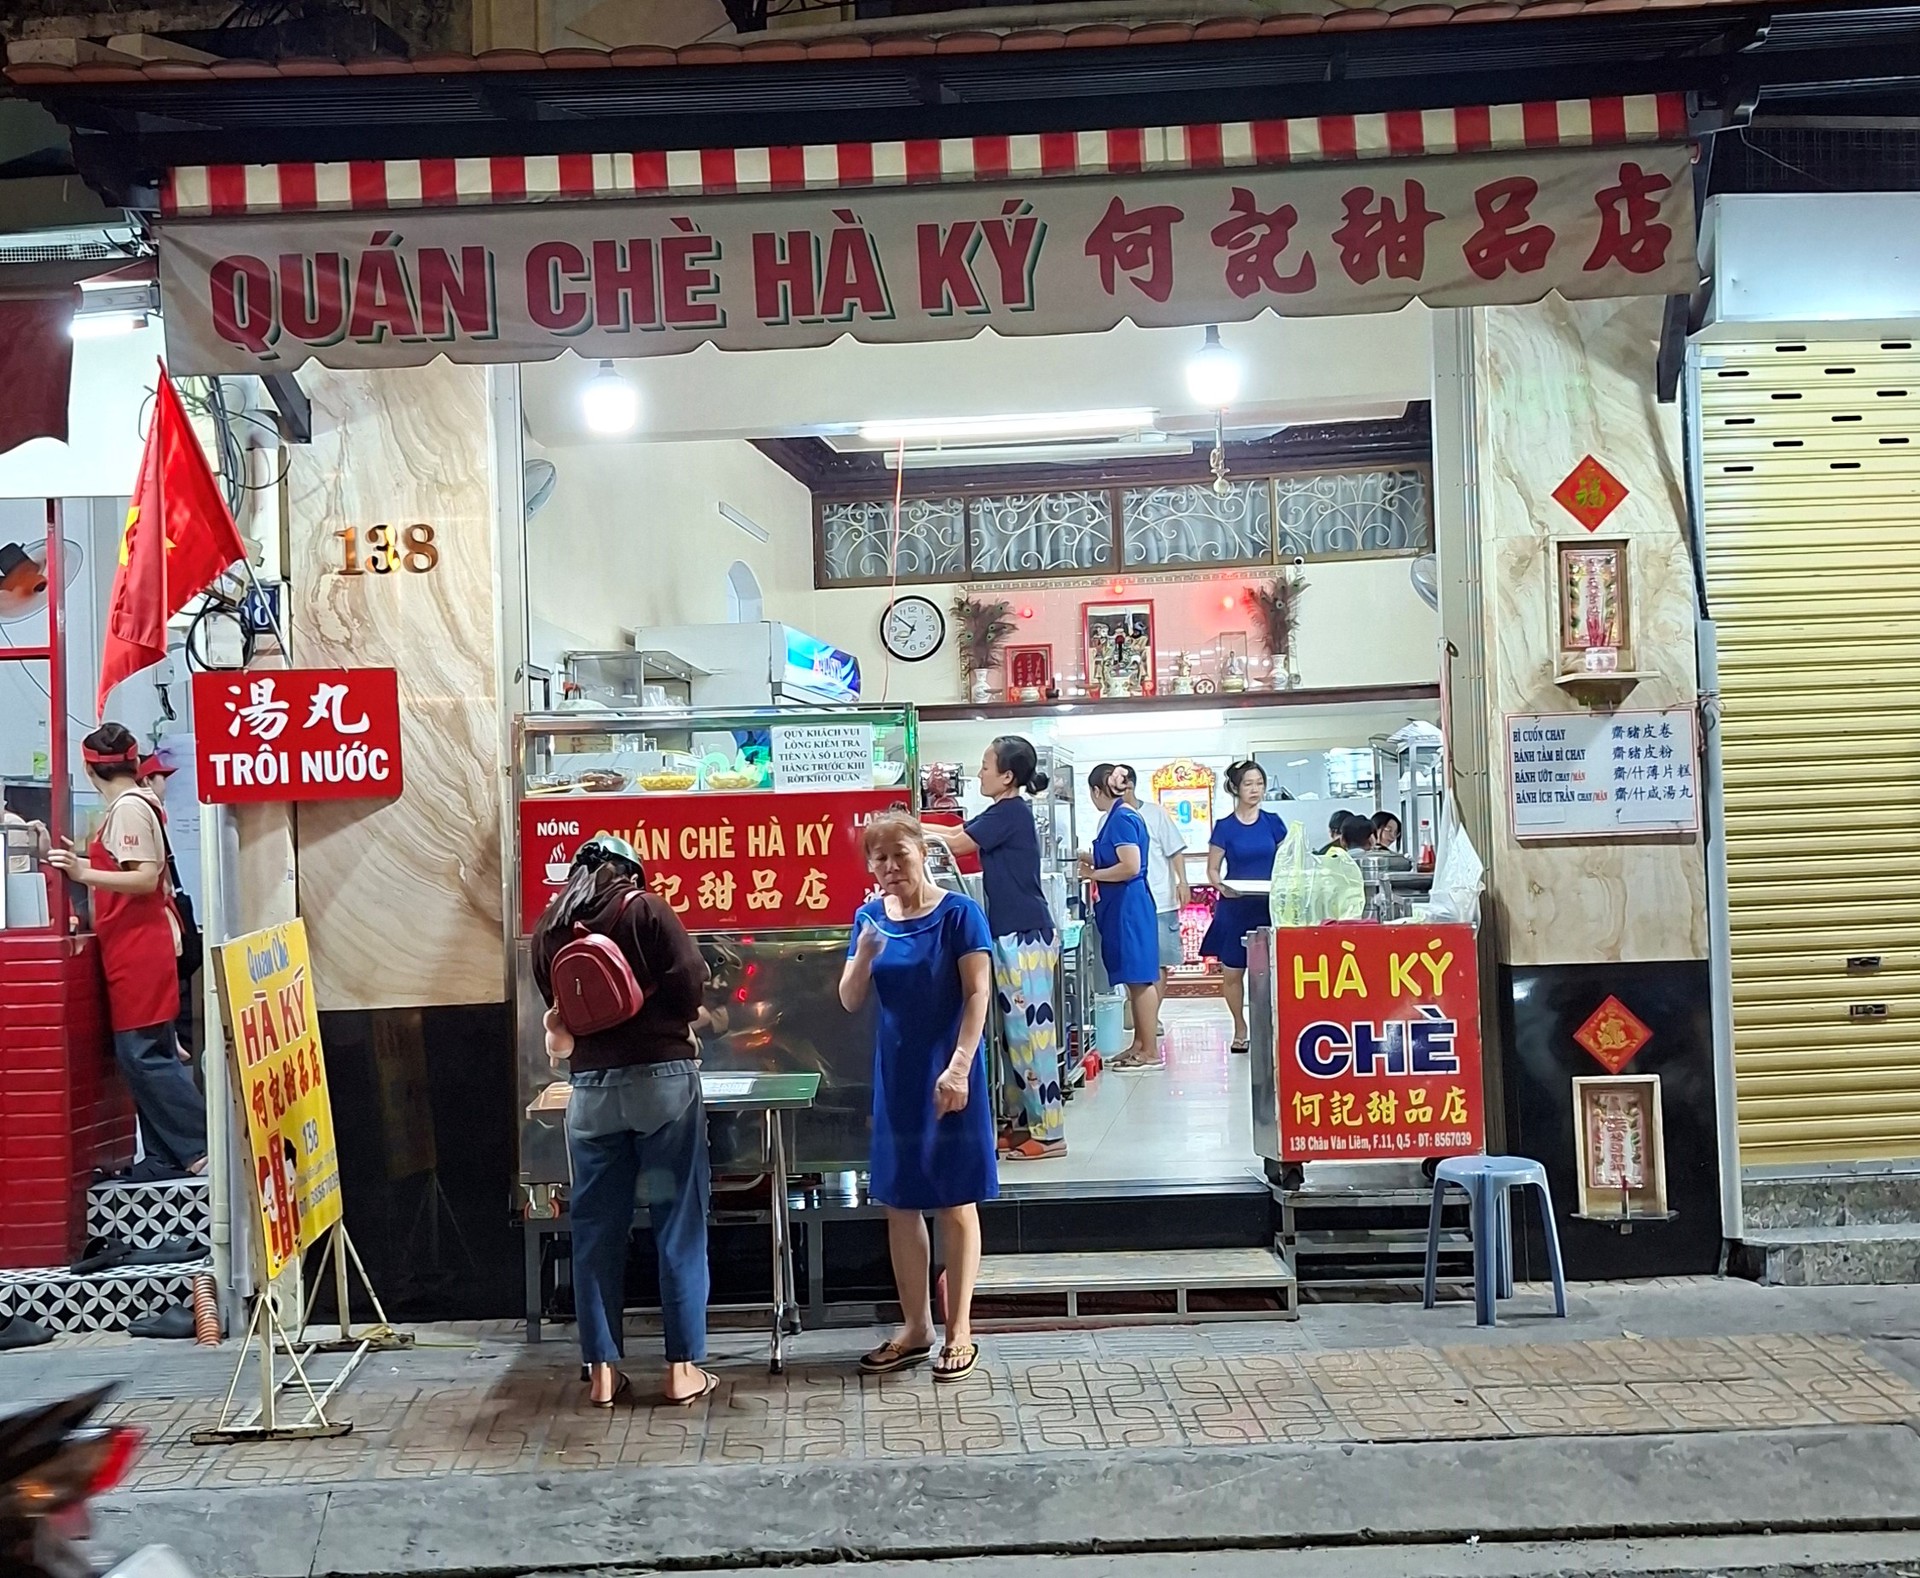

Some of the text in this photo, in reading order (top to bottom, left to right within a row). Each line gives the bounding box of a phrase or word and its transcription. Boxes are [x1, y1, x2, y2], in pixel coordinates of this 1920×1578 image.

[1084, 161, 1672, 302] 何記甜品店
[208, 198, 1047, 363] QUÁN CHÈ HÀ KÝ
[333, 523, 439, 576] 138
[224, 678, 370, 740] 湯丸
[784, 740, 811, 749] LÒNG
[807, 728, 840, 737] KHÁCH
[843, 728, 860, 736] VUI
[1545, 729, 1566, 741] CHAY
[209, 740, 389, 786] TRÔI NƯỚC
[782, 763, 809, 772] HÀNG
[803, 750, 816, 760] VÀ
[1514, 748, 1535, 763] BÁNH
[1565, 748, 1586, 761] CHAY
[1515, 770, 1536, 783] BÁNH
[1178, 800, 1191, 824] 9
[1516, 790, 1537, 804] BÁNH
[537, 818, 580, 836] NÓNG
[679, 817, 735, 859] CHÈ
[747, 815, 785, 857] HÀ
[796, 814, 834, 856] KÝ
[650, 867, 831, 913] 記甜品店
[1294, 937, 1454, 999] HÀ KÝ
[239, 963, 307, 1068] HÀ KÝ
[1295, 1004, 1460, 1079] CHÈ
[1291, 1085, 1468, 1127] 何記甜品店
[302, 1118, 320, 1156] 138
[1290, 1136, 1306, 1151] 138
[1308, 1136, 1329, 1150] Châu
[1396, 1133, 1410, 1149] Q.5
[1434, 1131, 1472, 1147] 8567039
